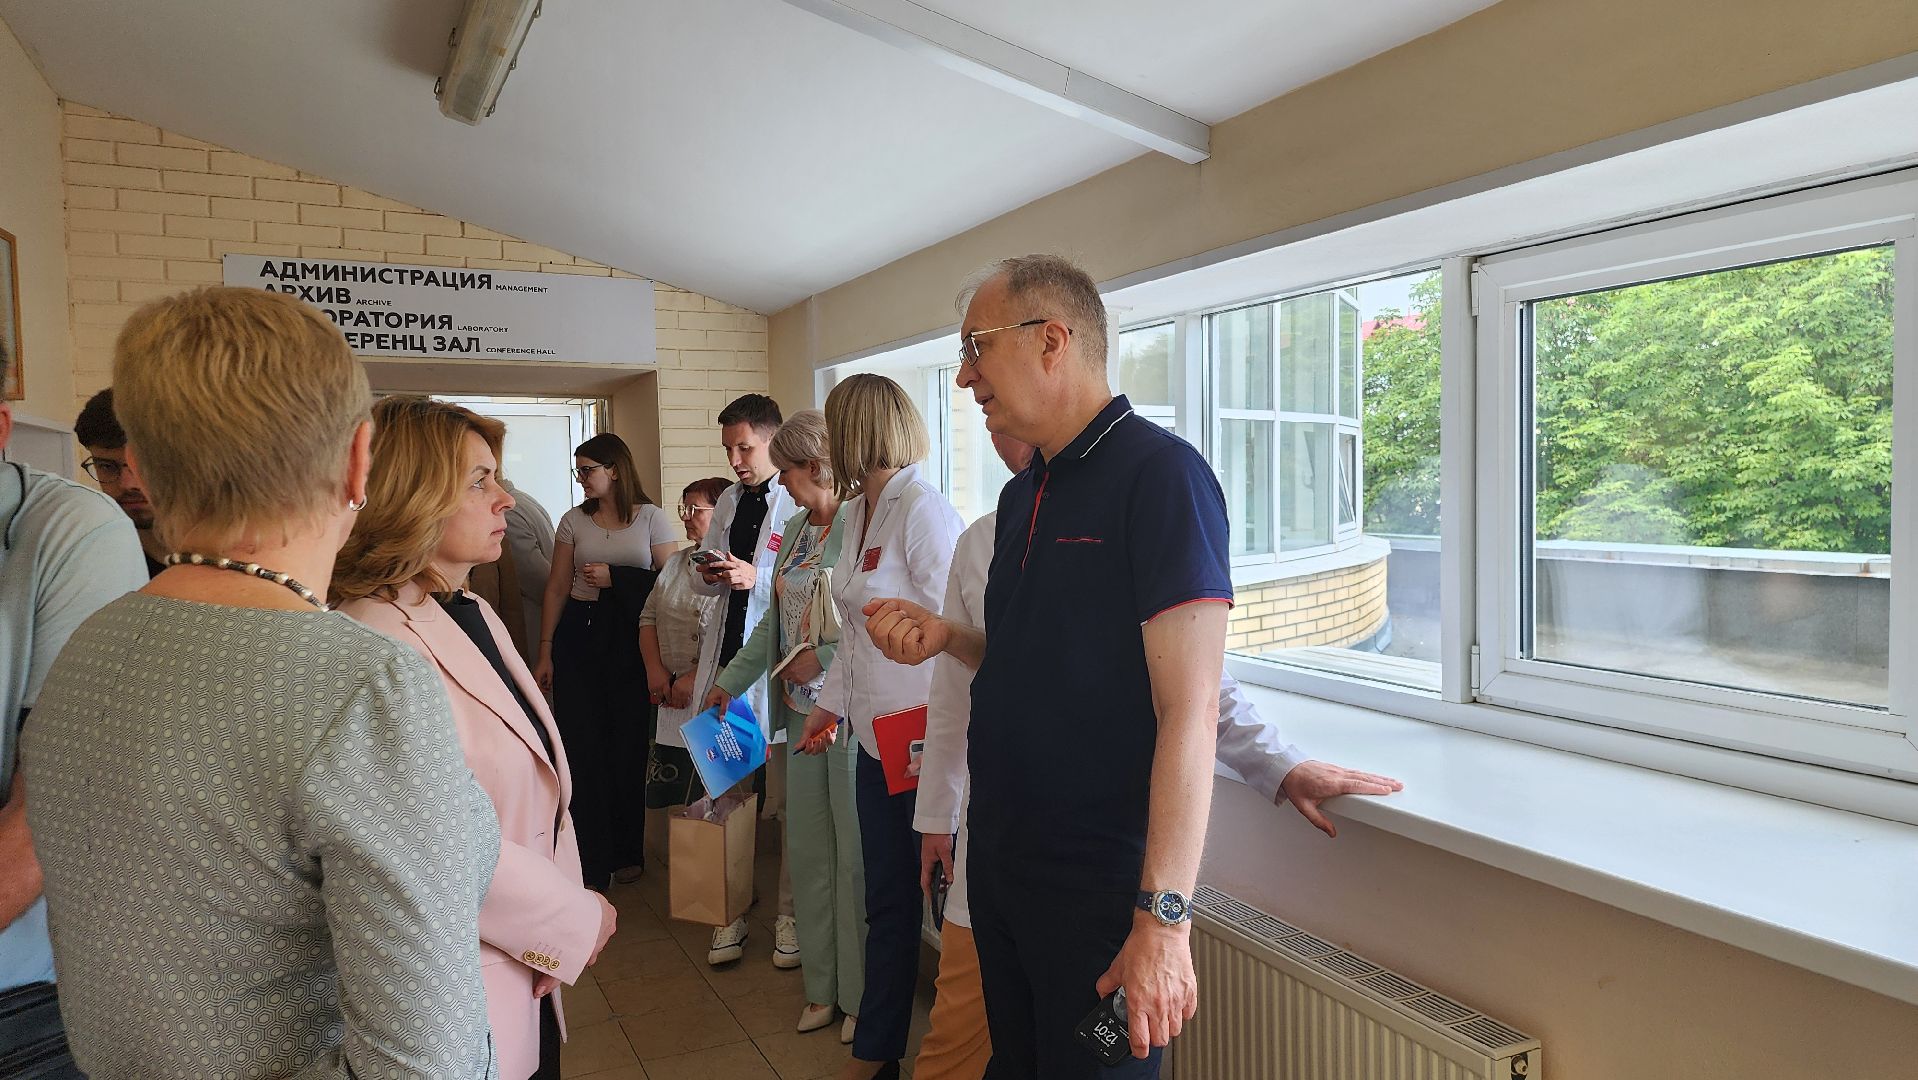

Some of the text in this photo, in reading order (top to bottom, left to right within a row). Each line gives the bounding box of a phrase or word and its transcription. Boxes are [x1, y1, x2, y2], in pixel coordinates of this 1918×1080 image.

[260, 260, 492, 290] АДМИНИСТРАЦИЯ
[496, 284, 548, 293] MANAGEMENT
[321, 309, 453, 331] ОРАТОРИЯ
[344, 332, 481, 353] ЕРЕНЦ ЗАЛ
[486, 347, 536, 355] CONFERENCE
[1094, 1021, 1119, 1045] 12:01
